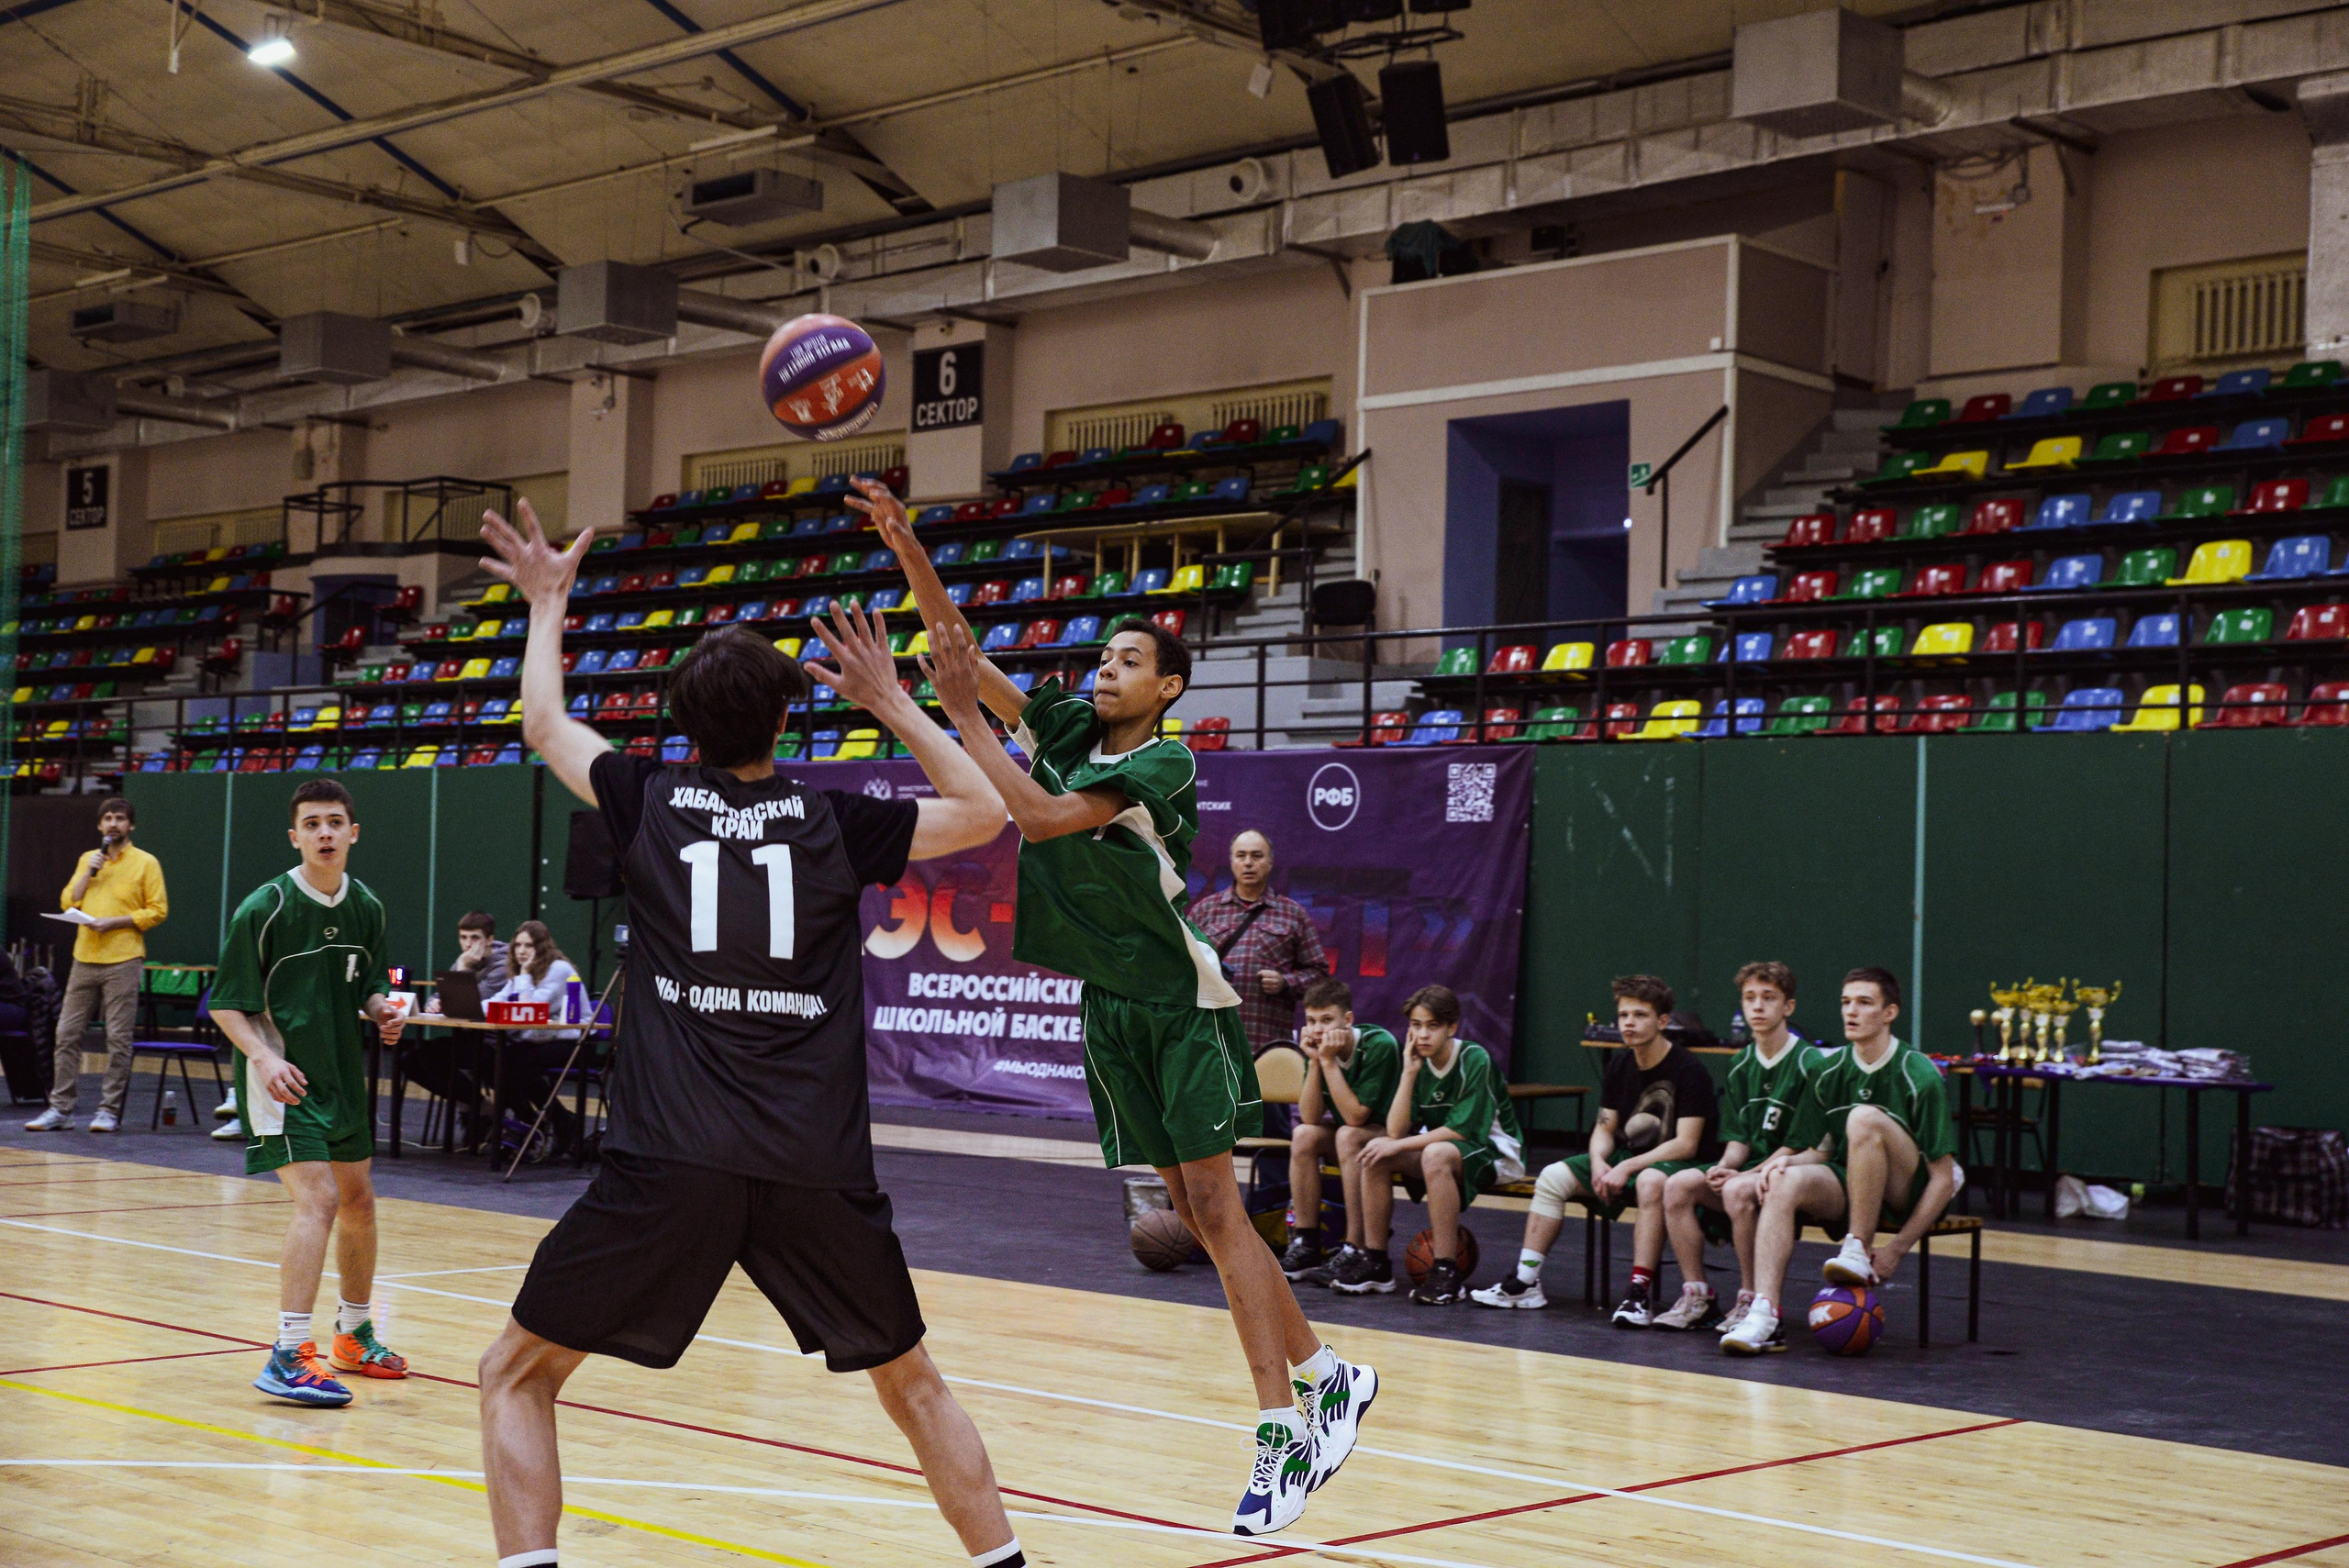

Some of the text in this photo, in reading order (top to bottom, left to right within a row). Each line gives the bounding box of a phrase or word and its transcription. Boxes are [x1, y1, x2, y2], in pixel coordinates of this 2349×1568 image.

[939, 350, 957, 396] 6
[916, 396, 979, 427] СЕКТОР
[83, 472, 94, 505] 5
[1313, 786, 1354, 806] РФБ
[679, 840, 796, 961] 11
[345, 953, 360, 983] 1
[689, 984, 742, 1013] ОДНА
[746, 988, 828, 1020] КОМАНДА!
[907, 972, 1083, 1006] ВСЕРОССИЙСКИ
[873, 1006, 1085, 1042] ШКОЛЬНОЙ БАСКЕ
[993, 1060, 1086, 1081] #МЫОДНАКО
